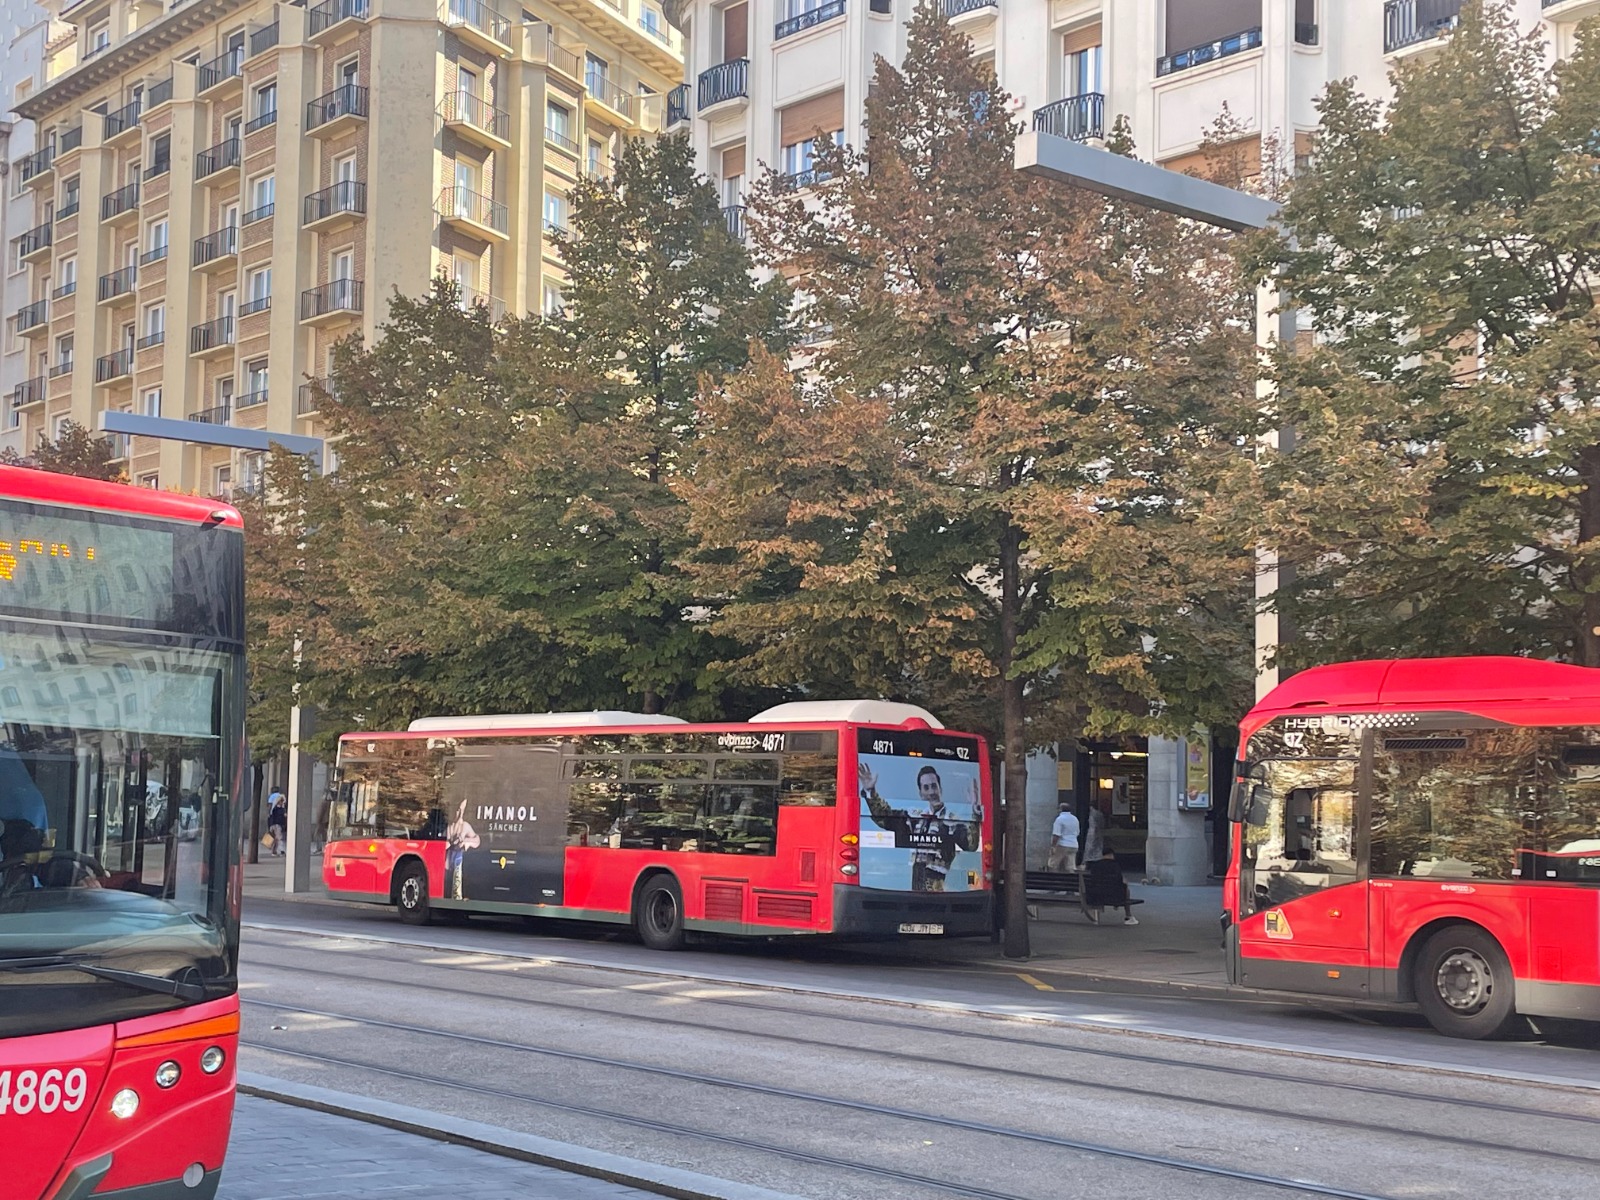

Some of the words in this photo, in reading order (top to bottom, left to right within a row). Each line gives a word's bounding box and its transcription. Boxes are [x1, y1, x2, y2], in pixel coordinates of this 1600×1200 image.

[1284, 716, 1350, 729] HYBRID
[762, 733, 785, 751] 4871
[872, 740, 894, 754] 4871
[476, 805, 538, 821] IMANOL
[909, 834, 943, 844] IMANOL
